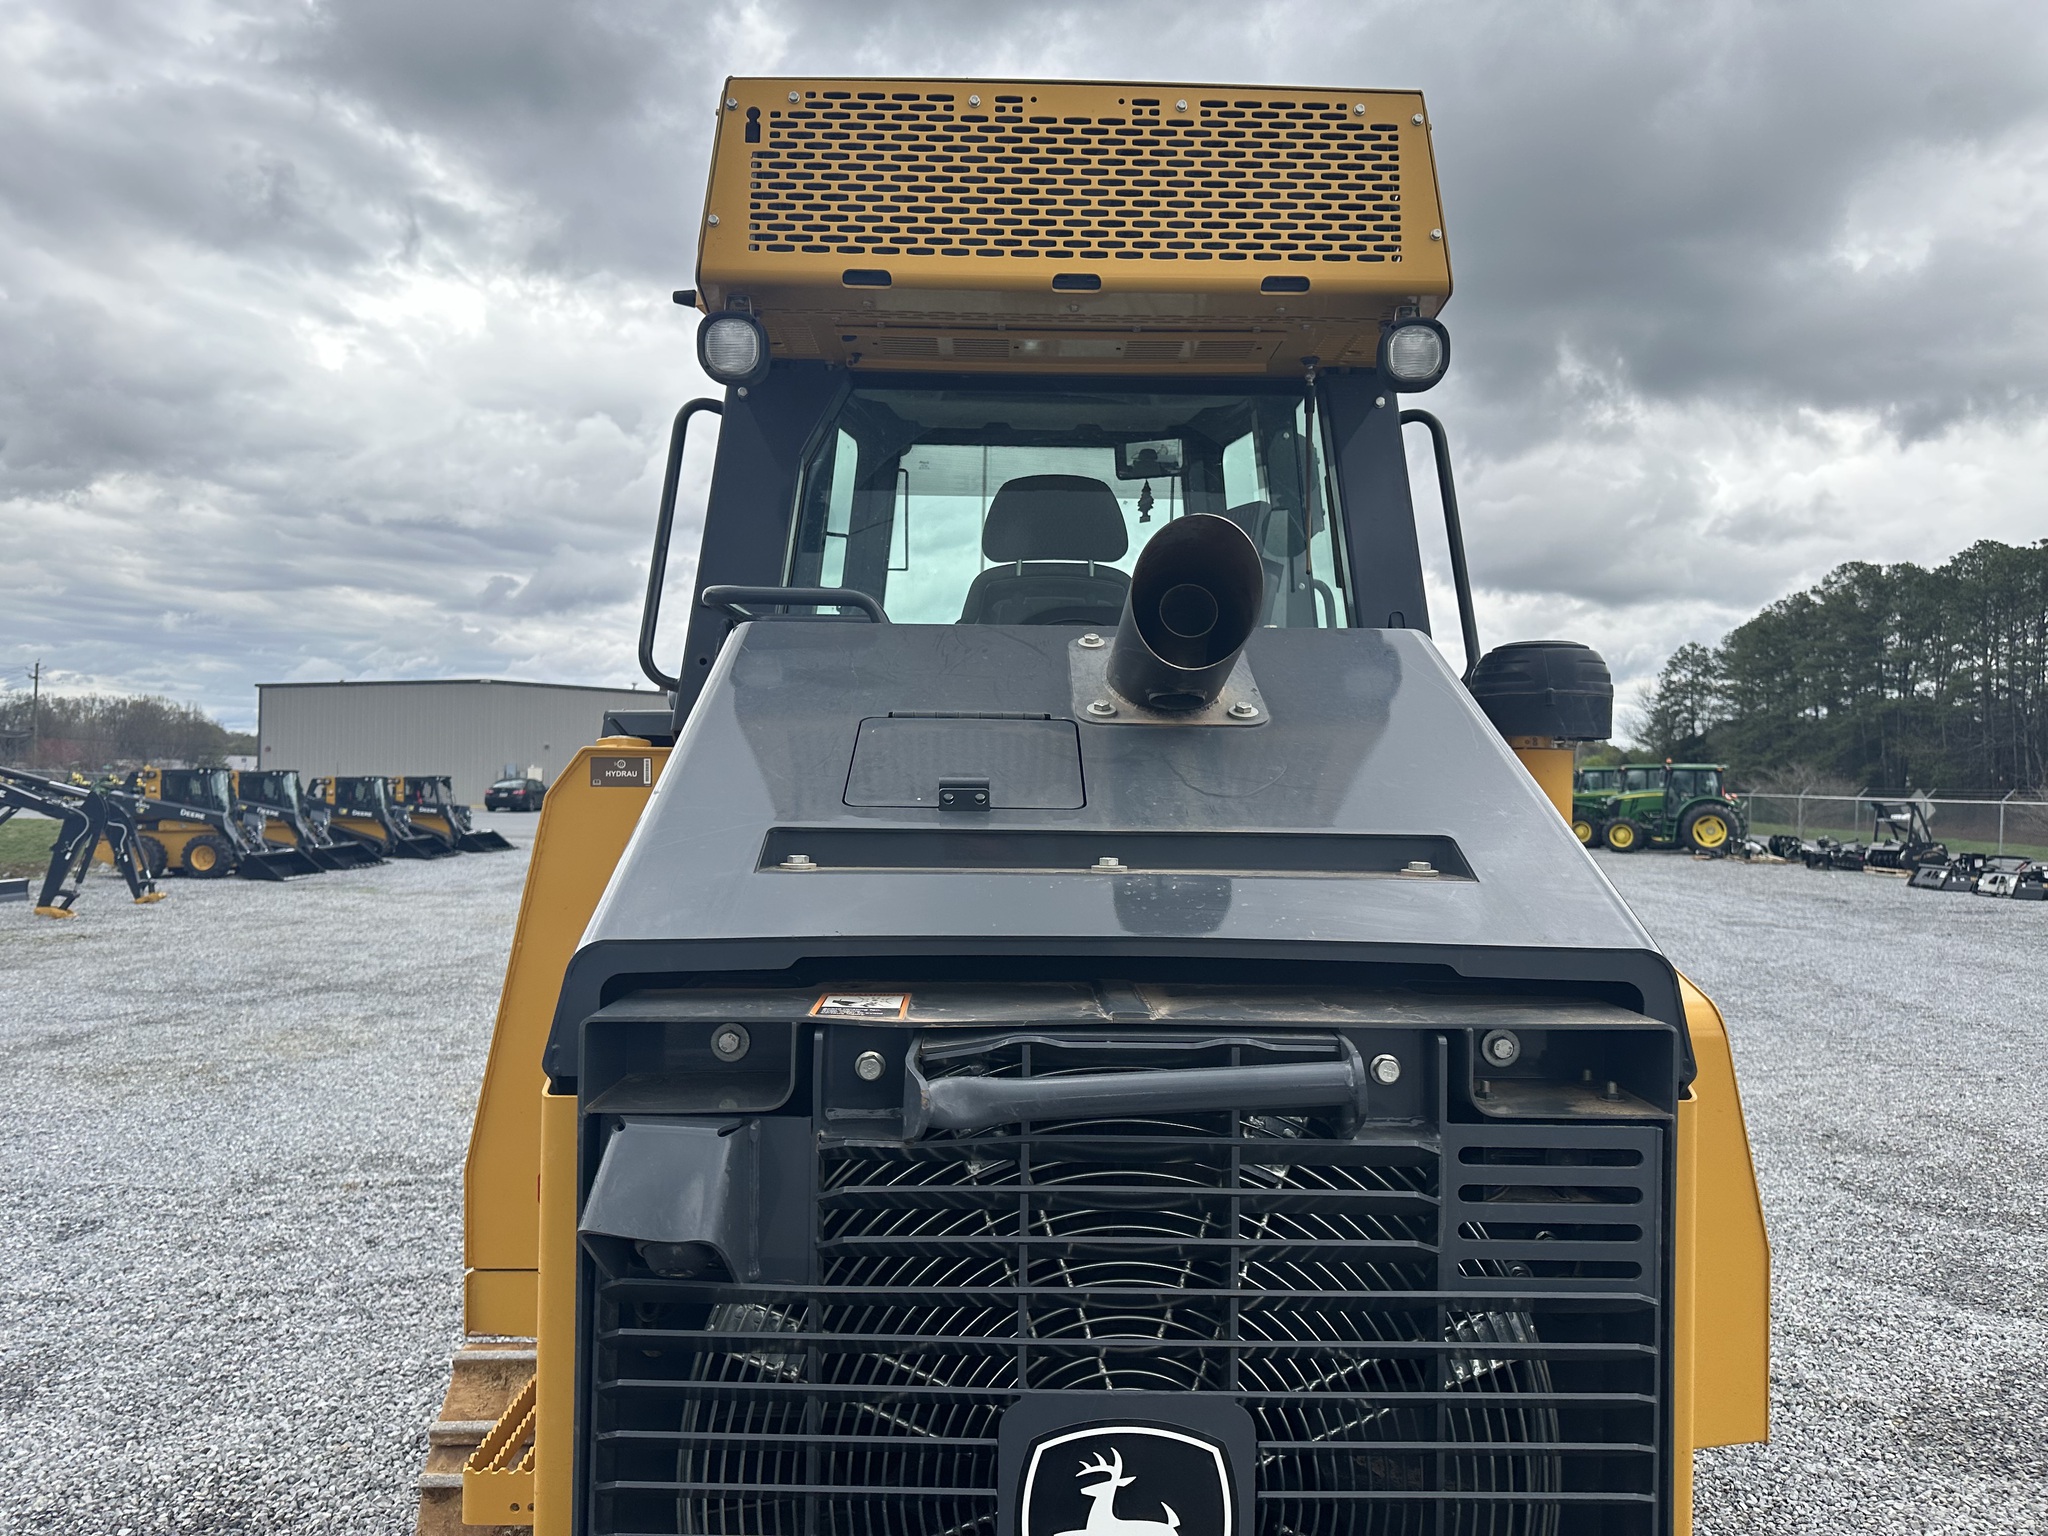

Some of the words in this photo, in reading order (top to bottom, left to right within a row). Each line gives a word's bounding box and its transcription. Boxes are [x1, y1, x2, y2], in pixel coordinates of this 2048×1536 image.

[605, 770, 638, 778] HYDRAU
[180, 809, 206, 820] DEERE
[352, 809, 372, 817] DEERE
